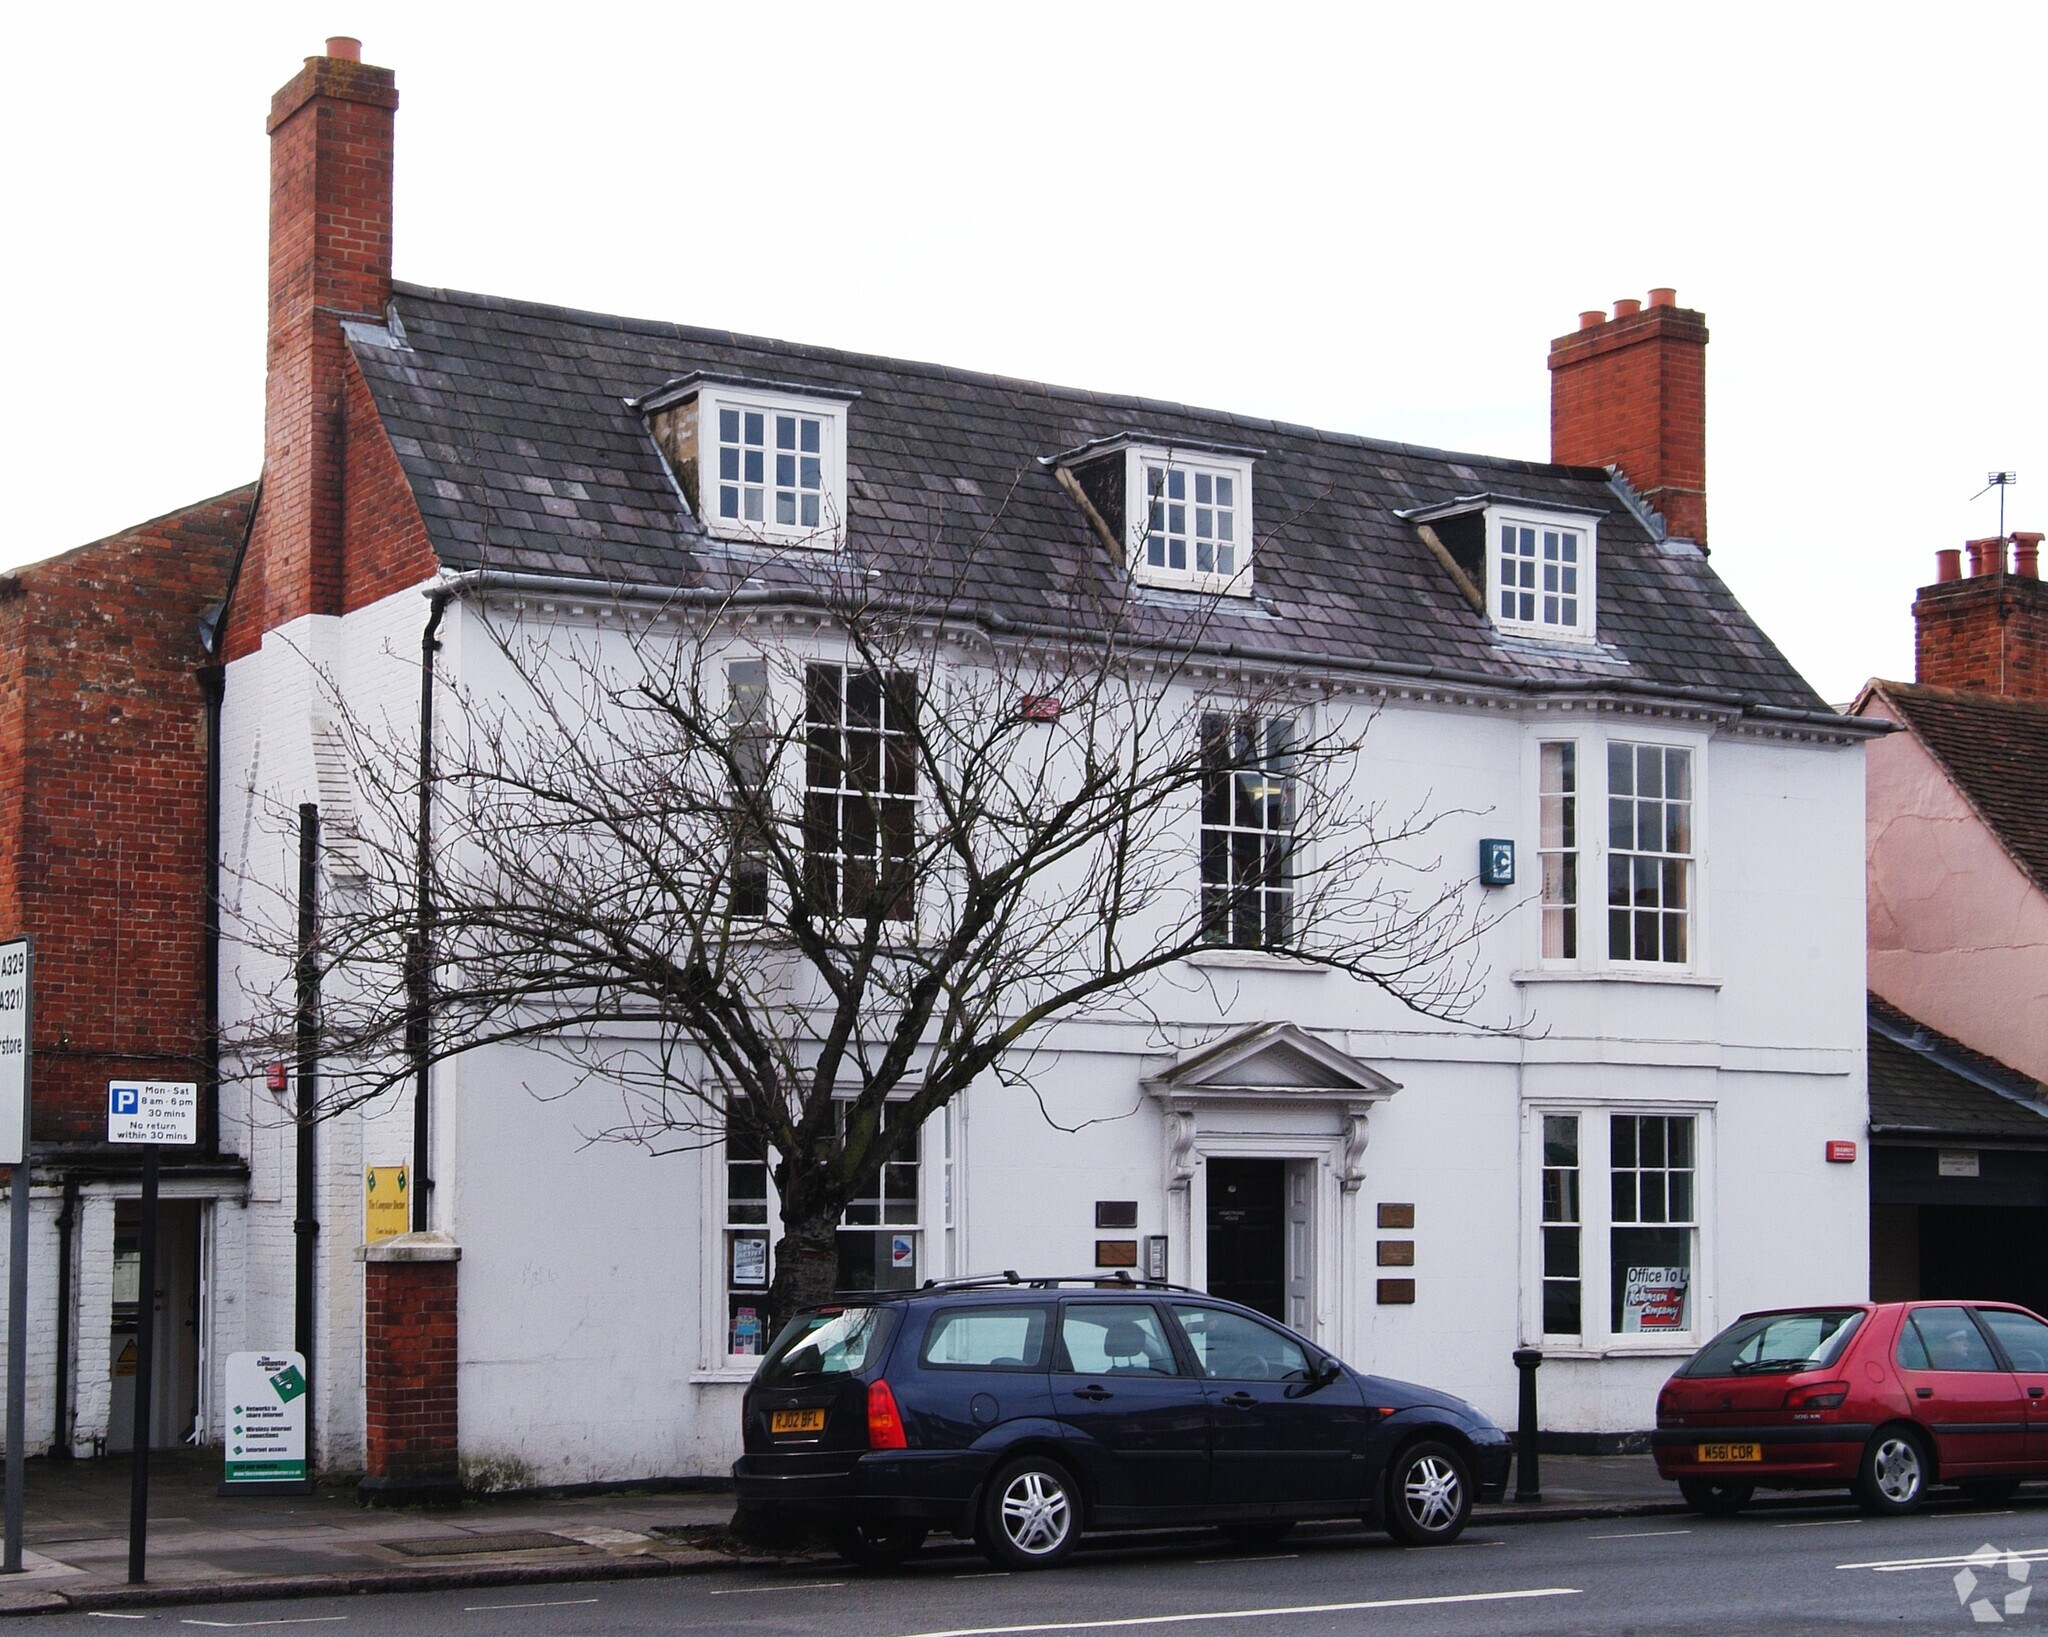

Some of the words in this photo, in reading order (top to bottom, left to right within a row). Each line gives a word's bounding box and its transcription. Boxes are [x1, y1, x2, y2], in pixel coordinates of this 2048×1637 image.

[1, 953, 24, 977] A329
[145, 1086, 165, 1094] Mon
[173, 1087, 189, 1095] Sat
[118, 1091, 135, 1112] P
[179, 1099, 193, 1107] pm
[148, 1109, 161, 1117] 30
[164, 1110, 186, 1118] mins
[147, 1122, 176, 1130] return
[117, 1131, 147, 1139] within
[166, 1132, 188, 1140] mins
[1629, 1268, 1661, 1282] Office
[1665, 1268, 1677, 1282] To
[1627, 1284, 1668, 1306] Robinson
[1641, 1302, 1679, 1321] Company
[776, 1412, 799, 1429] RJ02
[801, 1411, 819, 1427] BFL
[1731, 1445, 1753, 1459] COR
